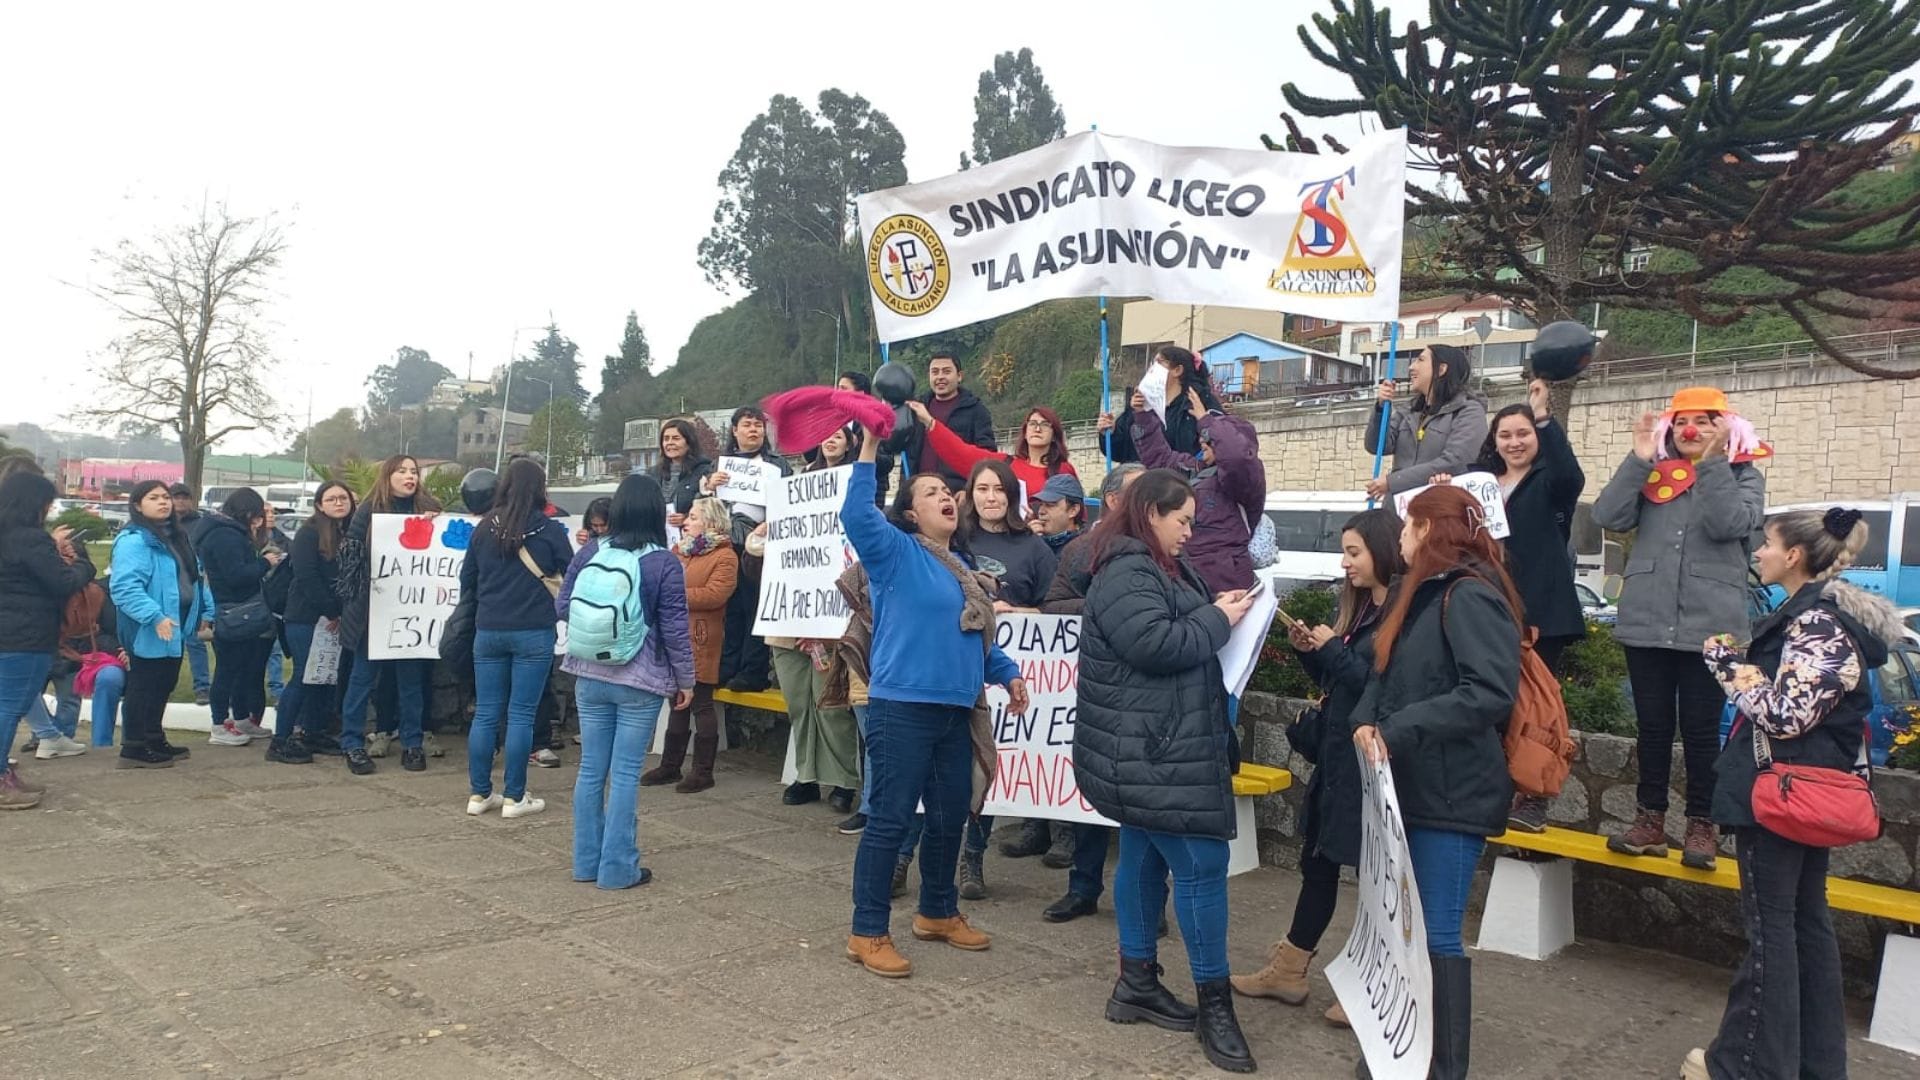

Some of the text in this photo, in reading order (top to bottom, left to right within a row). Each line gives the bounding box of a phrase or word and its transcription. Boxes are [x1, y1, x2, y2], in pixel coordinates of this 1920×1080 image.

[949, 161, 1266, 237] SINDICATO LICEO
[870, 234, 881, 273] LICEO
[882, 222, 895, 235] LA
[885, 279, 945, 312] TALCAHUANO
[1268, 280, 1377, 294] TALCAHUANO
[788, 471, 838, 505] ESCUCHEN
[767, 511, 845, 542] NUESTRAS JUSTA
[378, 554, 403, 579] LA
[781, 546, 831, 570] DEMANDAS
[399, 586, 425, 605] UN
[814, 587, 851, 618] DIGNIDA
[1018, 618, 1045, 654] LA
